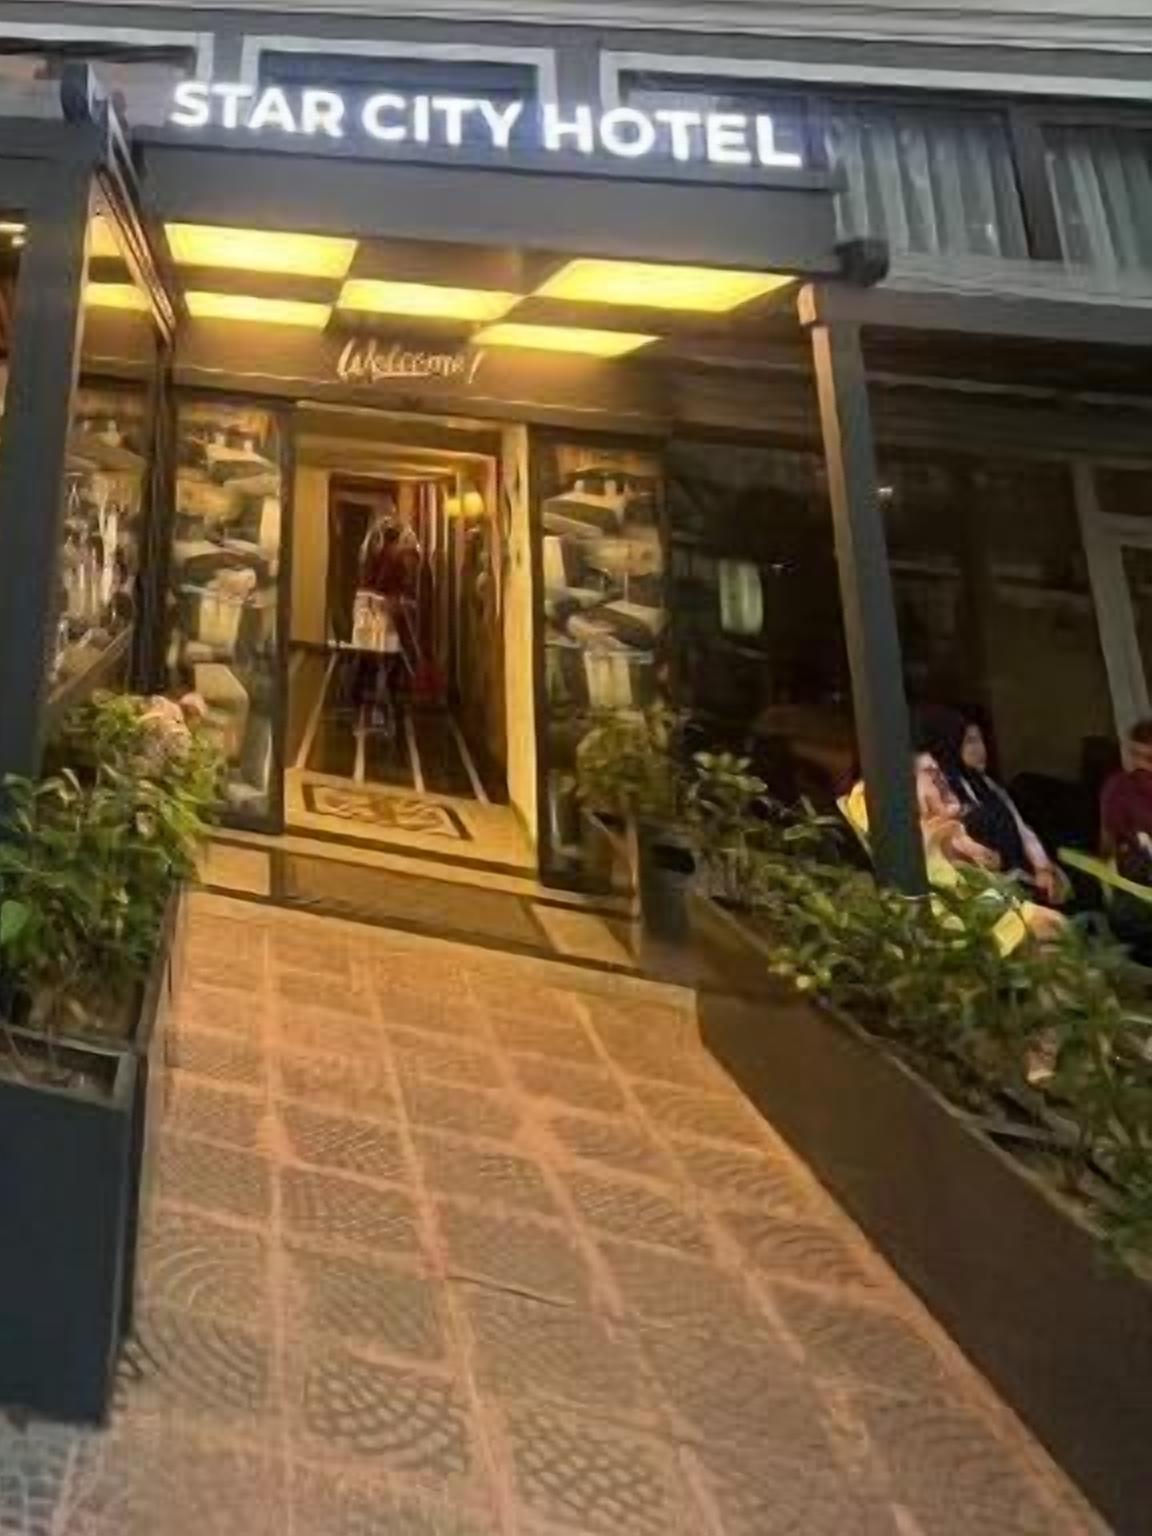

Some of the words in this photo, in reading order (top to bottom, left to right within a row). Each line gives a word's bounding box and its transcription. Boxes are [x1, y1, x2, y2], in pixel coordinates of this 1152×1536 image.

[169, 80, 344, 139] STAR
[362, 92, 522, 149] CITY
[543, 103, 803, 168] HOTEL
